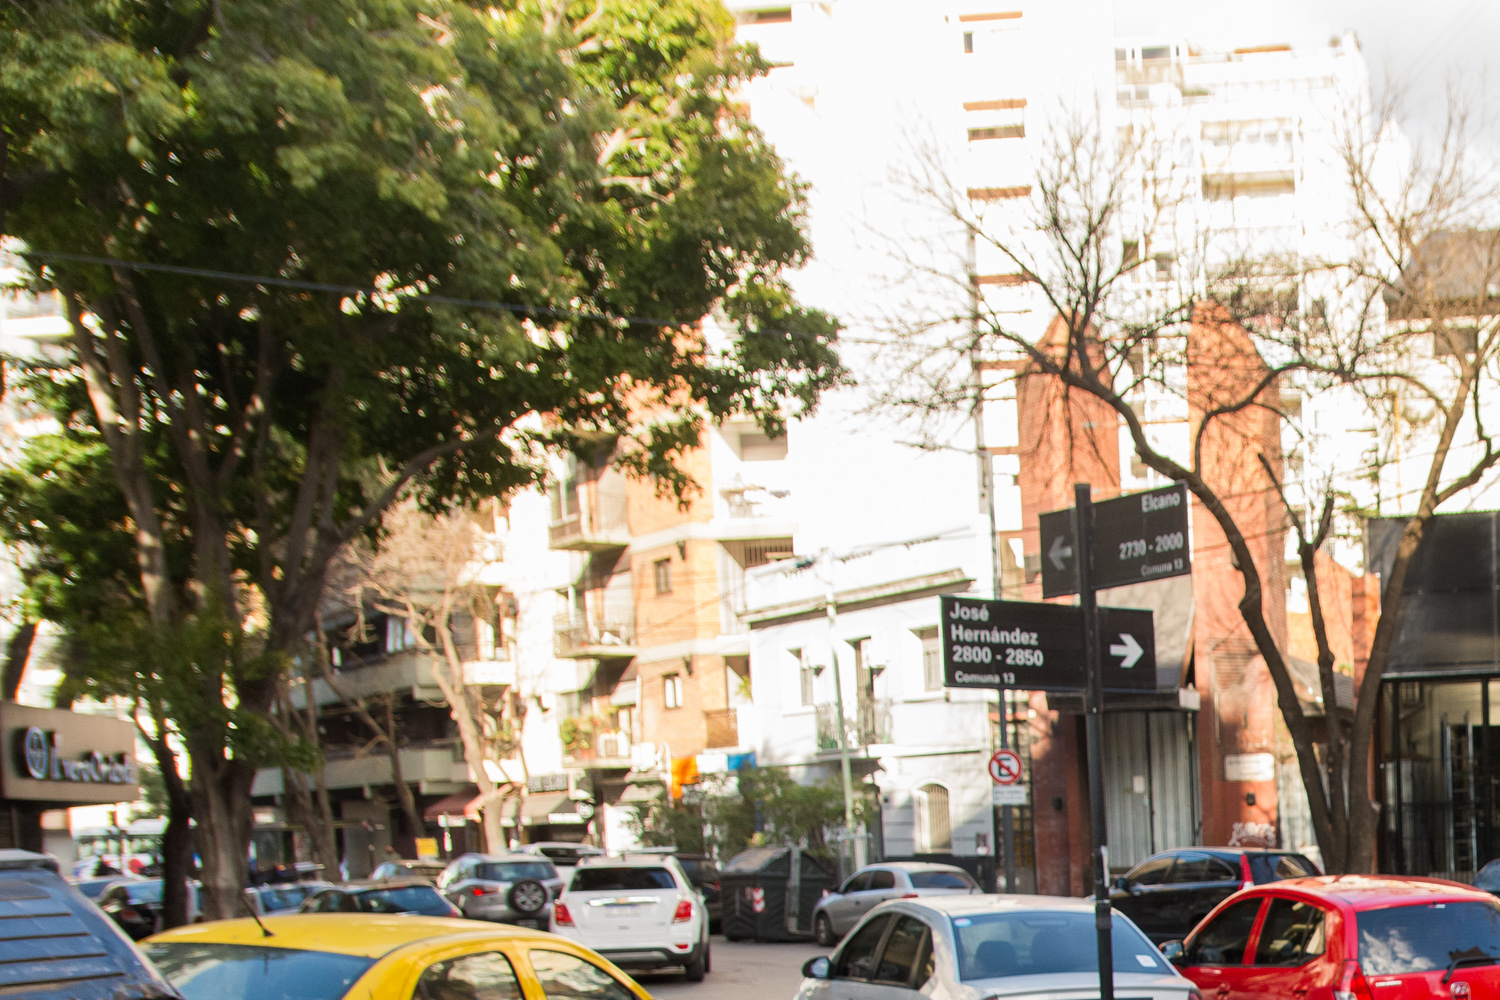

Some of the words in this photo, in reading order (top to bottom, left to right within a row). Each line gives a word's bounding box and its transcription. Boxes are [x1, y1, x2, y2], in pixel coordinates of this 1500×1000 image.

[1141, 492, 1181, 513] Elcano
[1119, 538, 1146, 560] 2730
[1155, 532, 1184, 552] 2000
[1140, 559, 1173, 577] Comuna
[1174, 557, 1184, 570] 13
[949, 601, 990, 622] José
[950, 624, 1039, 646] Hernández
[952, 645, 992, 664] 2800
[1005, 647, 1044, 666] 2850
[955, 670, 1000, 684] Comuna
[1003, 672, 1016, 685] 13
